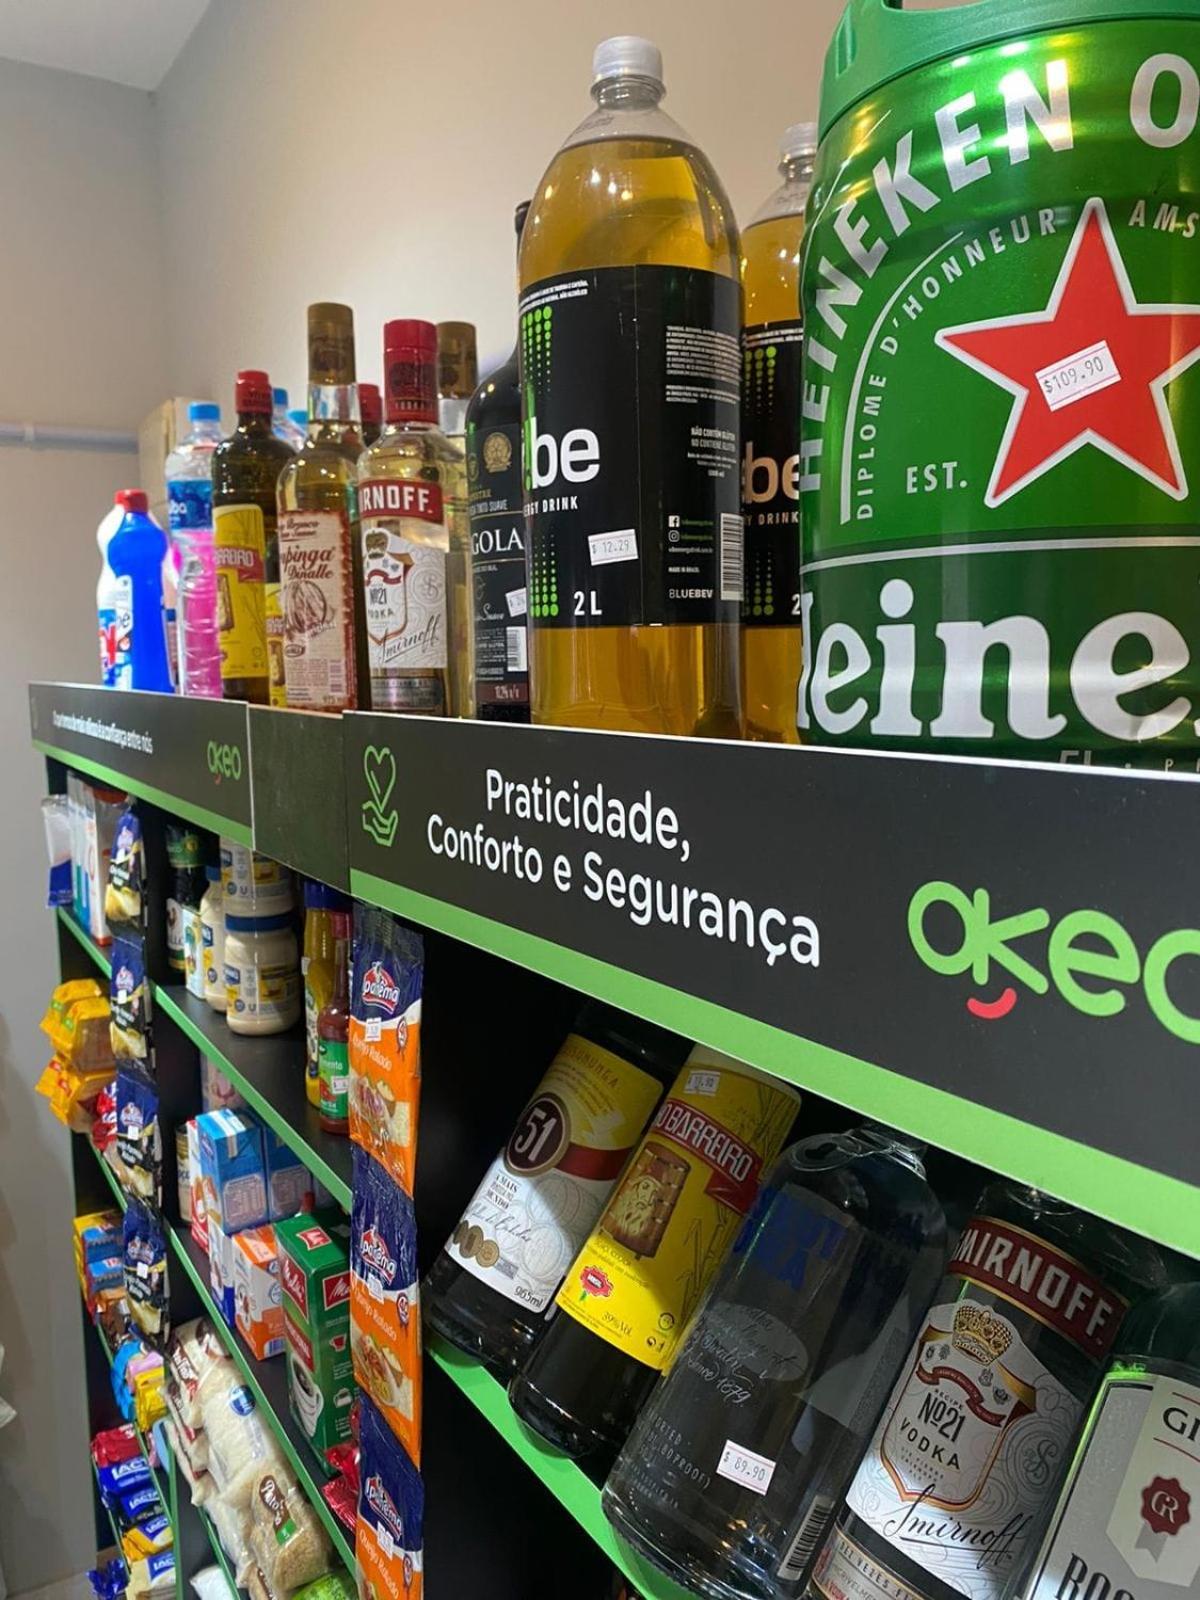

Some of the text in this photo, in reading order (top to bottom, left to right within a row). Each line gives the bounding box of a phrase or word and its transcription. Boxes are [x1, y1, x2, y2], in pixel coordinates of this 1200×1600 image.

[856, 208, 1057, 520] DIPLOME D'HONNEUR
[543, 496, 579, 512] DRINK
[906, 461, 969, 494] EST.
[758, 511, 800, 526] DRINK
[797, 577, 1200, 742] eine
[485, 768, 690, 862] Praticidade,
[427, 814, 821, 968] Conforto e Segurança
[513, 1105, 557, 1163] 51
[664, 1106, 753, 1182] BARREIRO
[899, 1416, 961, 1470] VODKA
[883, 1482, 1034, 1571] Smirnoff
